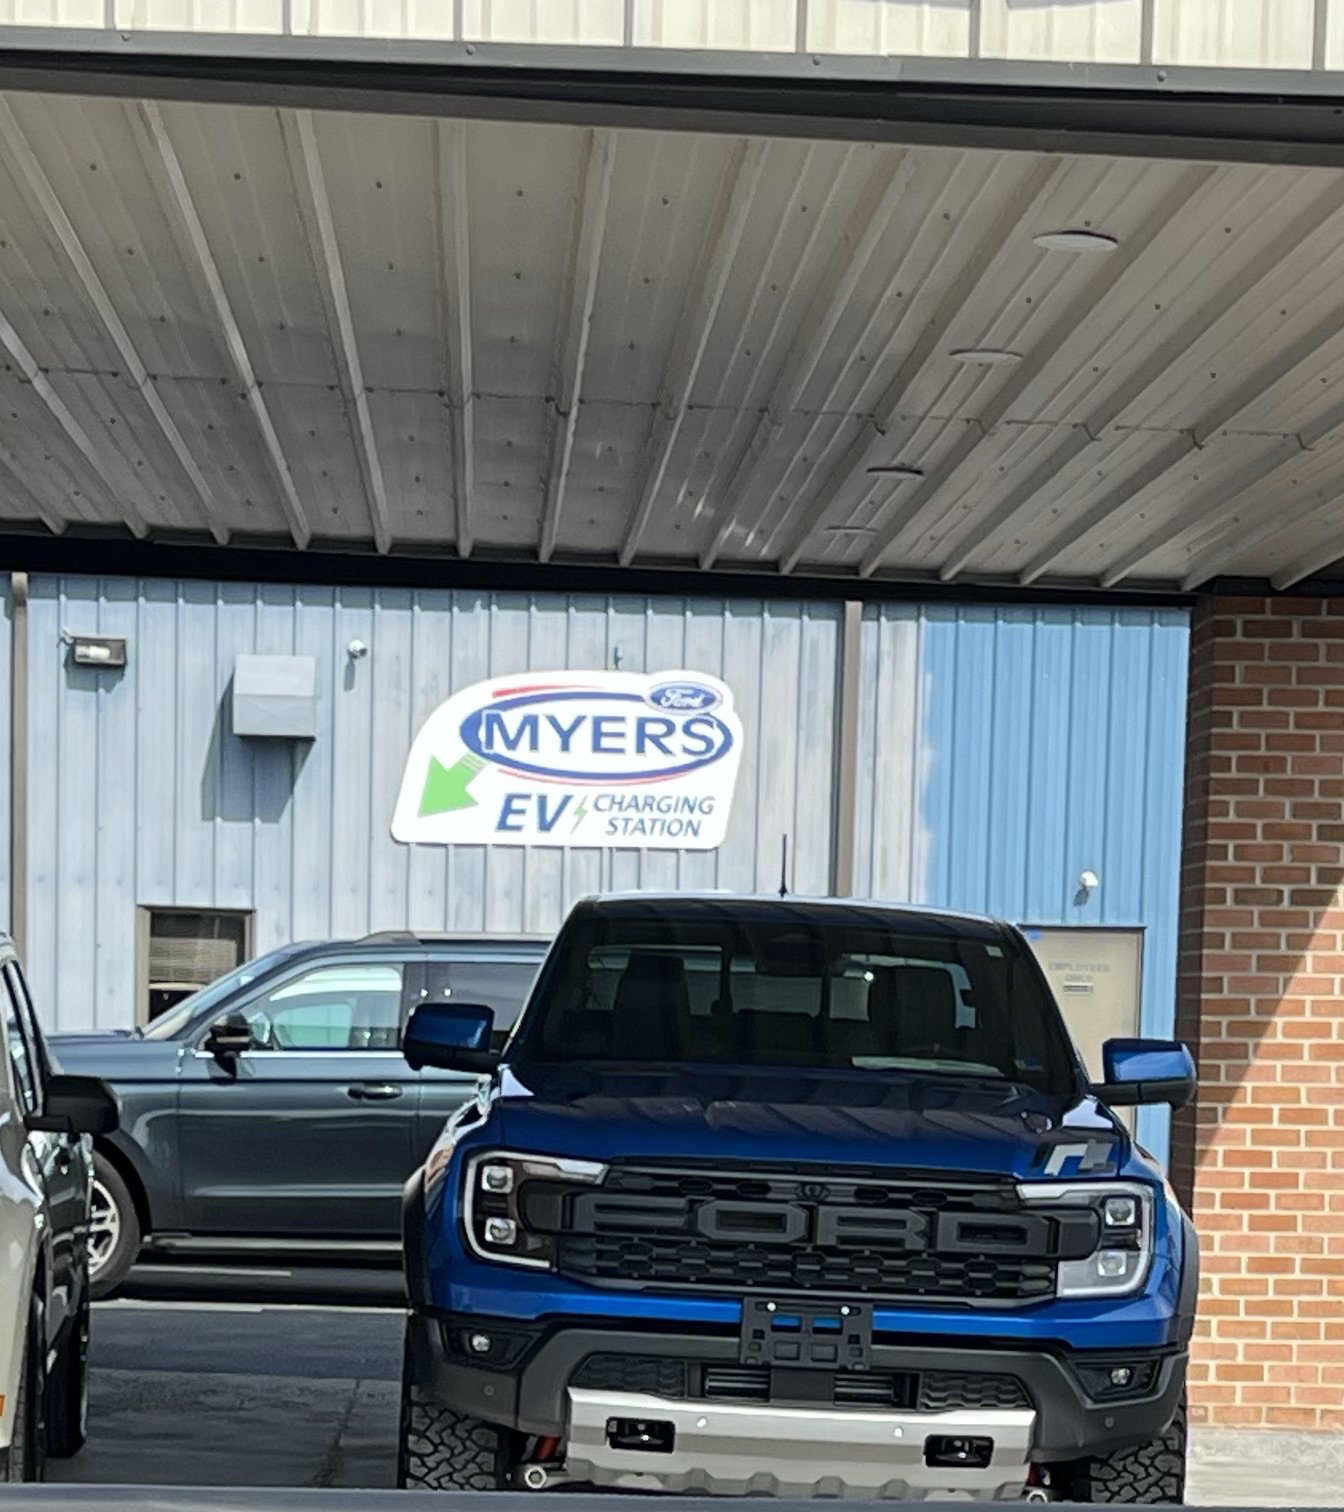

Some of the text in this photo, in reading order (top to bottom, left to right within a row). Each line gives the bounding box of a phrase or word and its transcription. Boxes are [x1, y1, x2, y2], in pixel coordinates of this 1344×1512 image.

[483, 713, 719, 757] MYERS
[495, 793, 575, 833] EV
[593, 793, 716, 816] CHARGING
[605, 816, 702, 838] STATION
[575, 1192, 1050, 1256] FORD
